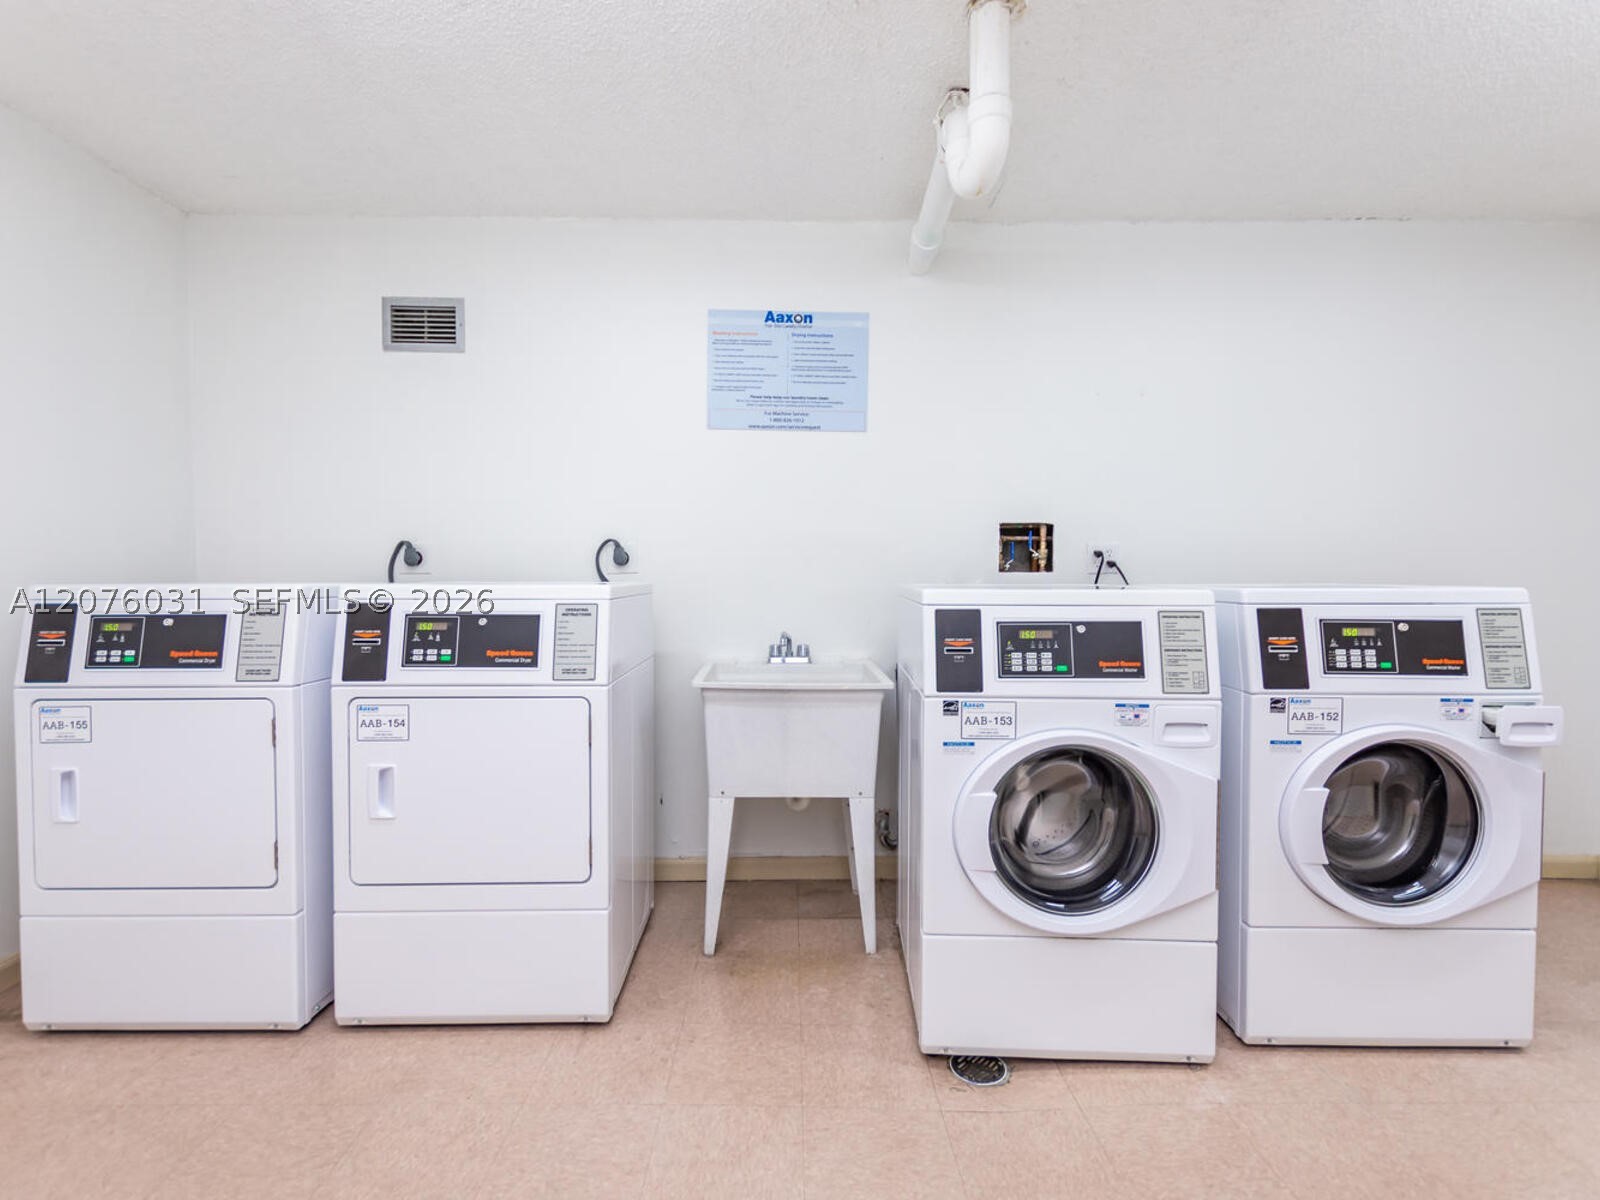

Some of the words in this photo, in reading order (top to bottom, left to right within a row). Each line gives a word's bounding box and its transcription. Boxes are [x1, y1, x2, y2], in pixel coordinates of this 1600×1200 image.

[764, 310, 813, 324] Aaxon
[170, 649, 194, 658] Speed
[194, 649, 218, 657] Queen
[486, 649, 509, 658] Speed
[510, 649, 534, 657] Queen
[964, 716, 1013, 726] AAB-153
[1291, 712, 1339, 721] AAB-152
[43, 720, 88, 730] AAB-155
[360, 718, 405, 728] AAB-154
